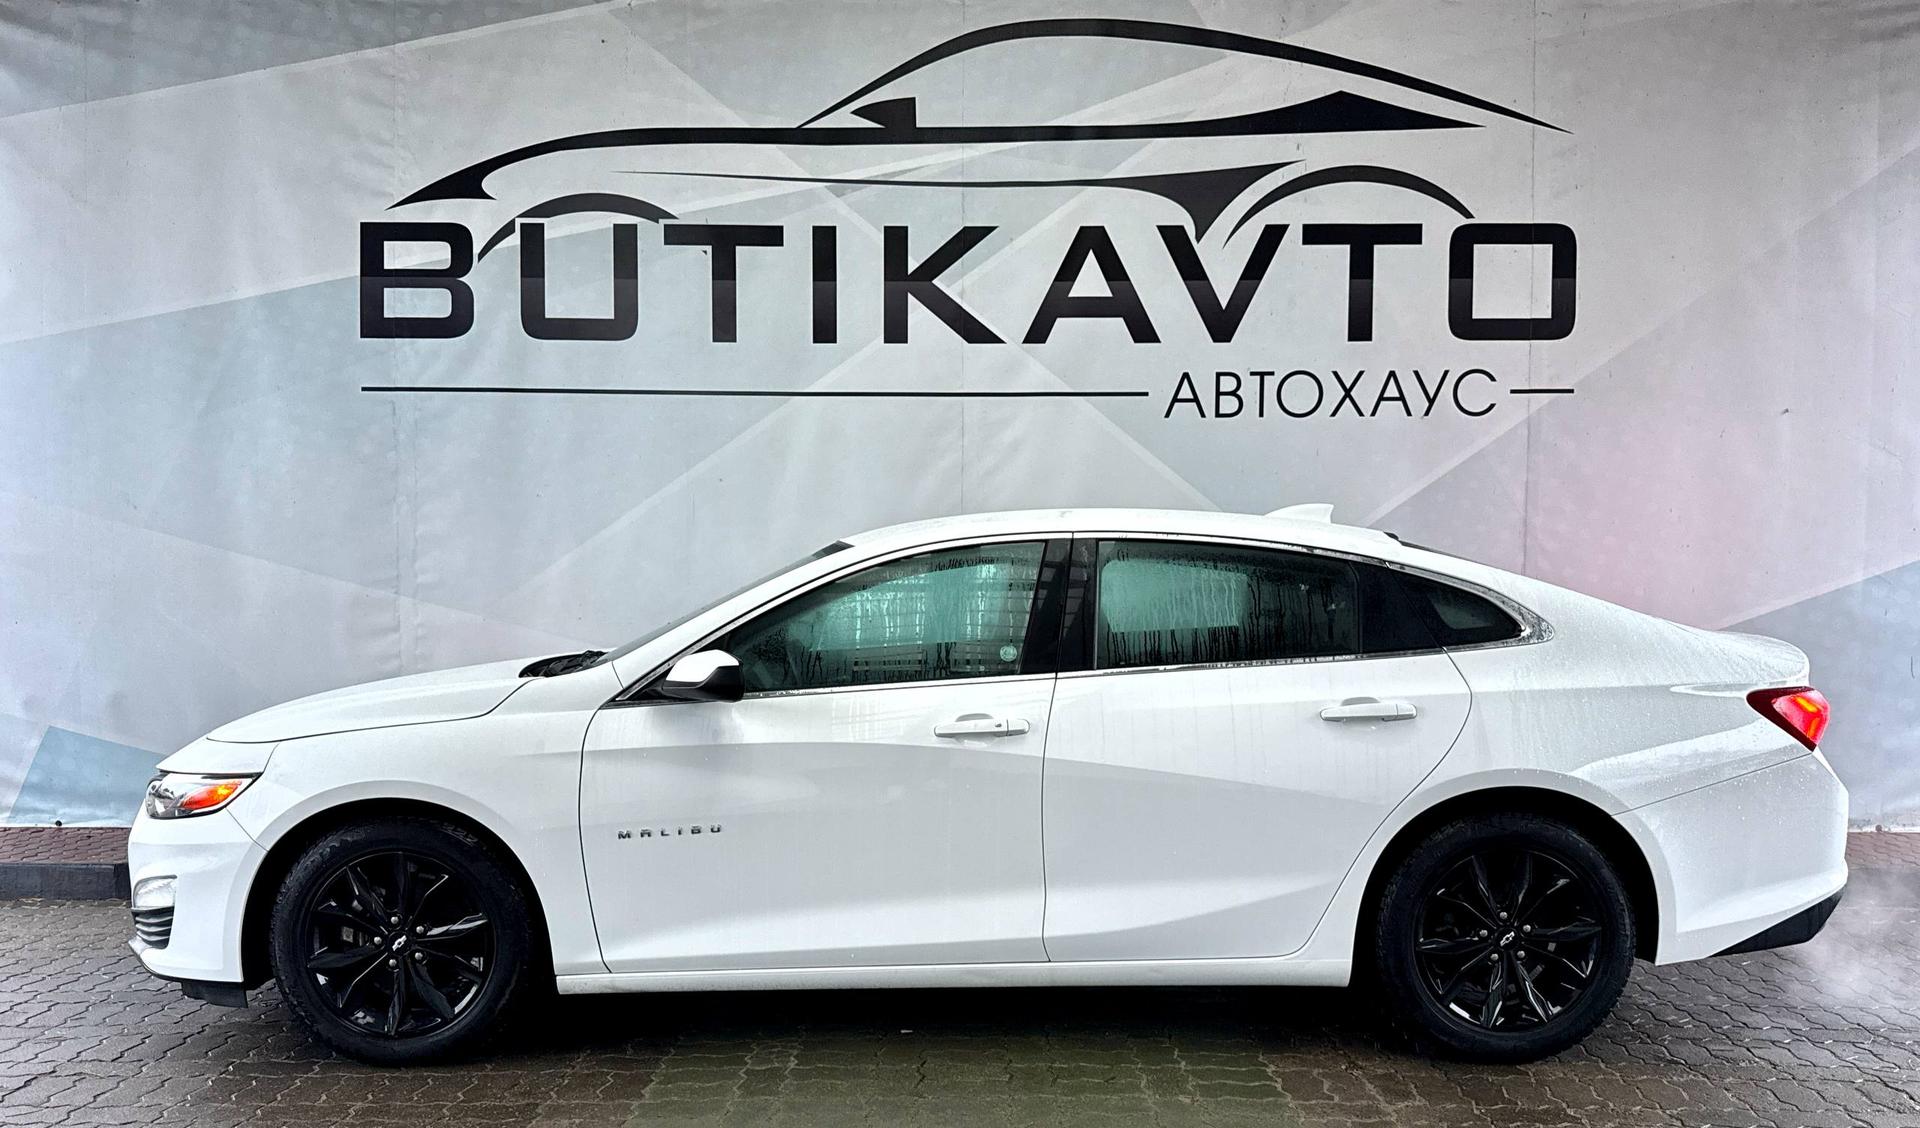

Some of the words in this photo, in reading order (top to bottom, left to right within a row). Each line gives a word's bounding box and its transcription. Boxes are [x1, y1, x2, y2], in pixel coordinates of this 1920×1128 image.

[360, 222, 1578, 344] BUTIKAVTO
[1164, 369, 1497, 419] АВТОХАУС
[617, 824, 722, 840] MALIBU
